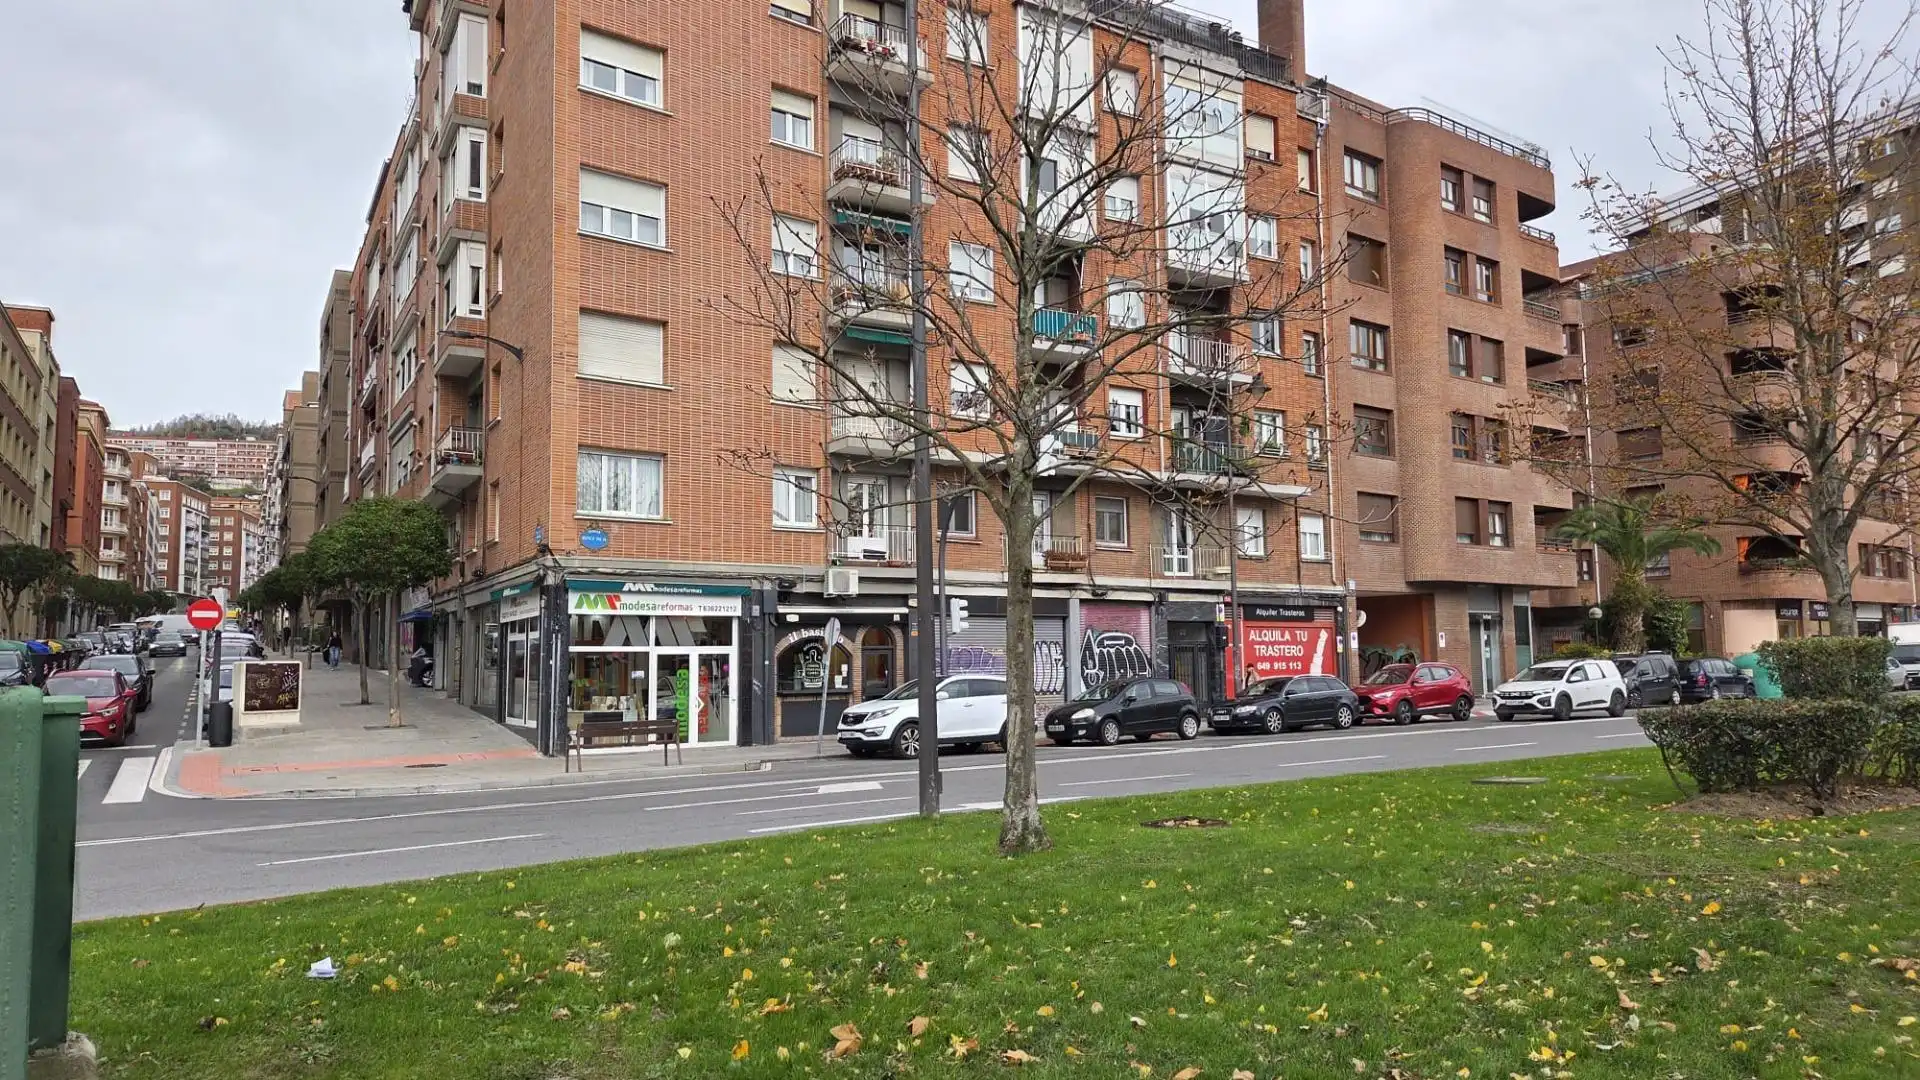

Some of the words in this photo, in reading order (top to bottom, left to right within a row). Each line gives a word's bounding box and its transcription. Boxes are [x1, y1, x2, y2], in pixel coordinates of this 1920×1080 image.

[1256, 608, 1278, 617] Alquiler
[1280, 608, 1306, 617] Trasteros
[801, 627, 844, 643] basio
[1249, 629, 1291, 642] ALQUILA
[1295, 630, 1308, 642] TU
[1254, 644, 1304, 657] TRASTERO
[1257, 661, 1270, 671] 649
[1273, 661, 1287, 671] 915
[1289, 661, 1302, 671] 113
[676, 669, 689, 738] modesa
